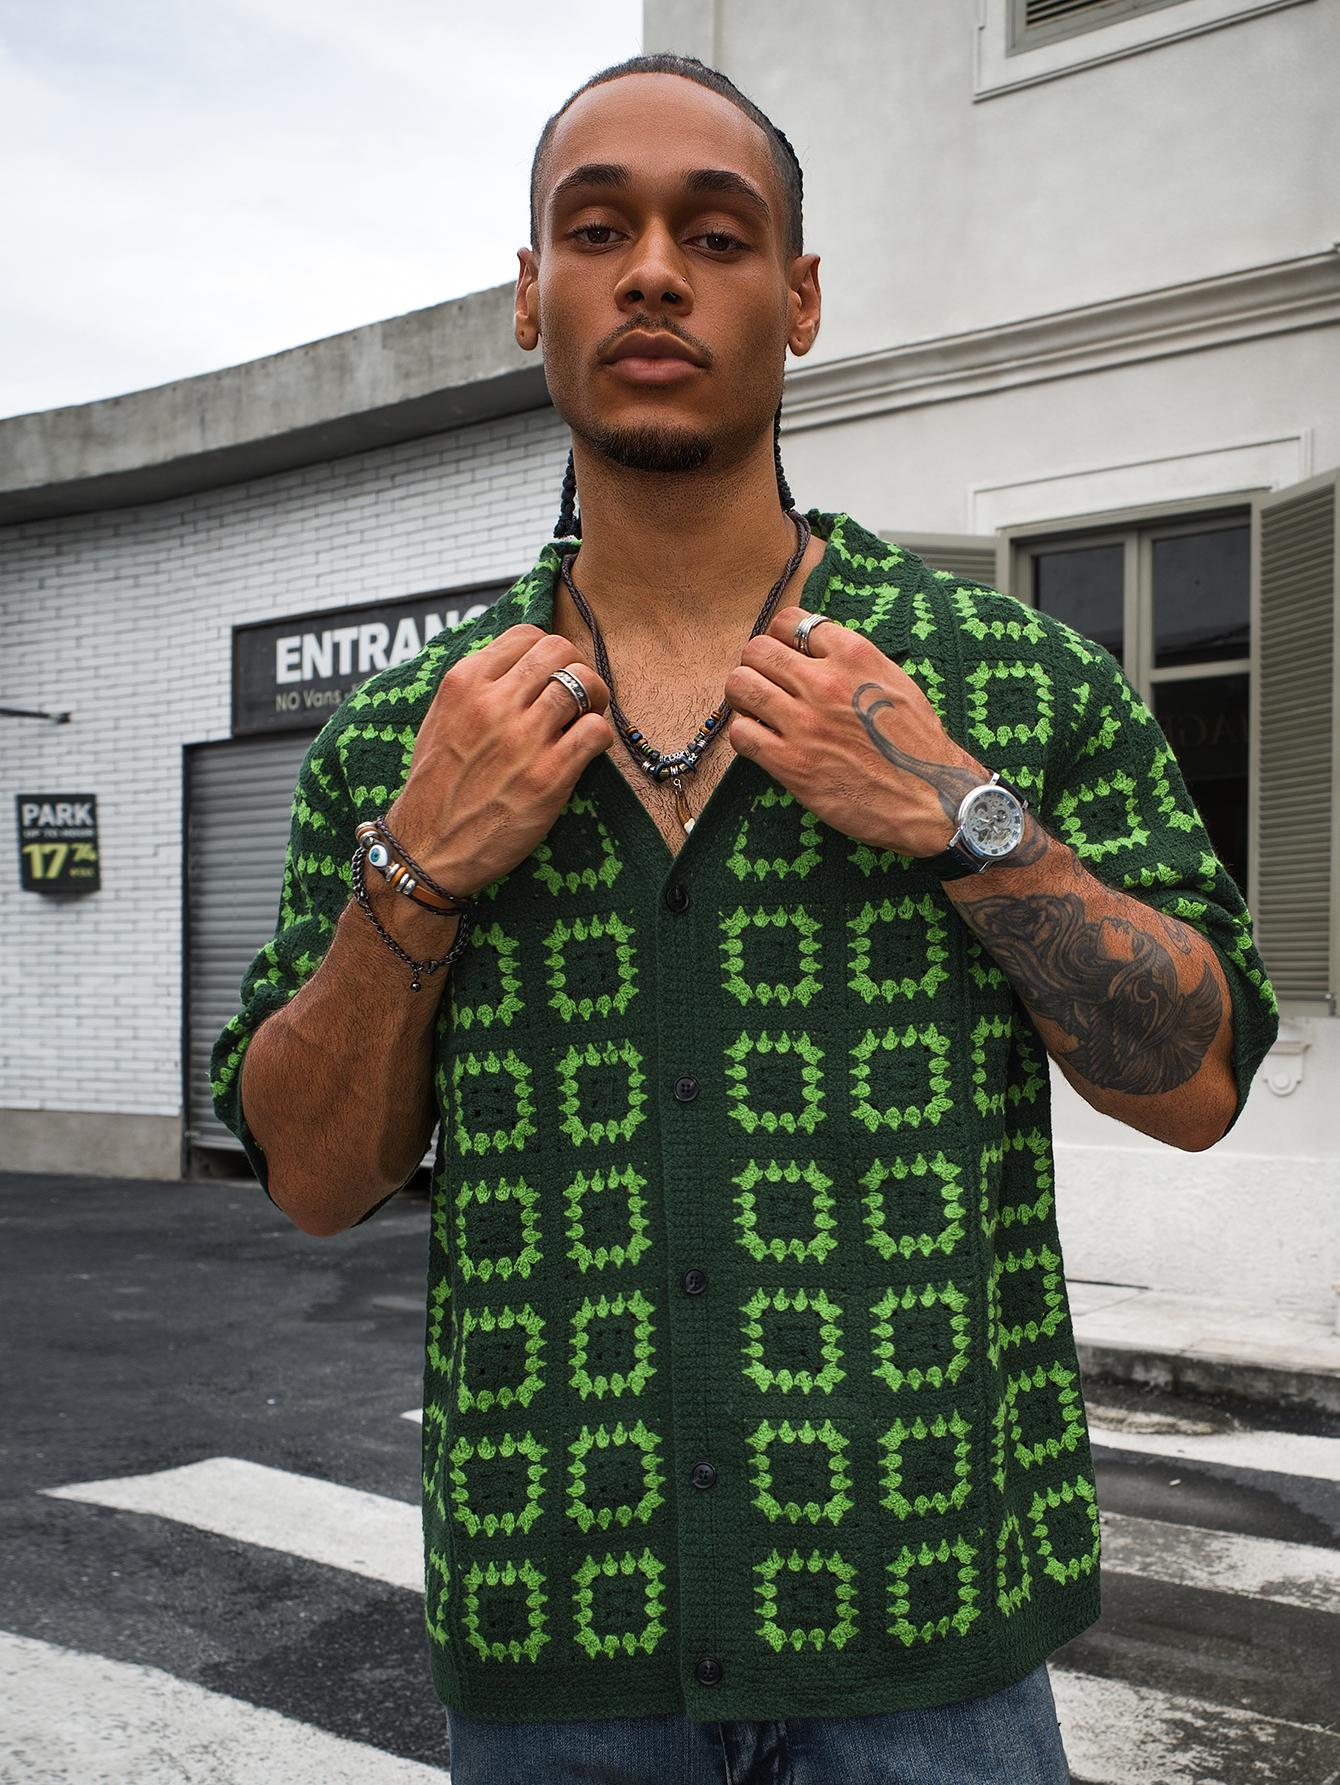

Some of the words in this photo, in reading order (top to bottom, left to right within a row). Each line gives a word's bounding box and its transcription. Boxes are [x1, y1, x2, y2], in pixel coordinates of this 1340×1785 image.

[276, 604, 489, 684] ENTRAN
[276, 691, 300, 712] NO
[303, 689, 341, 708] Vans
[22, 803, 93, 826] PARK
